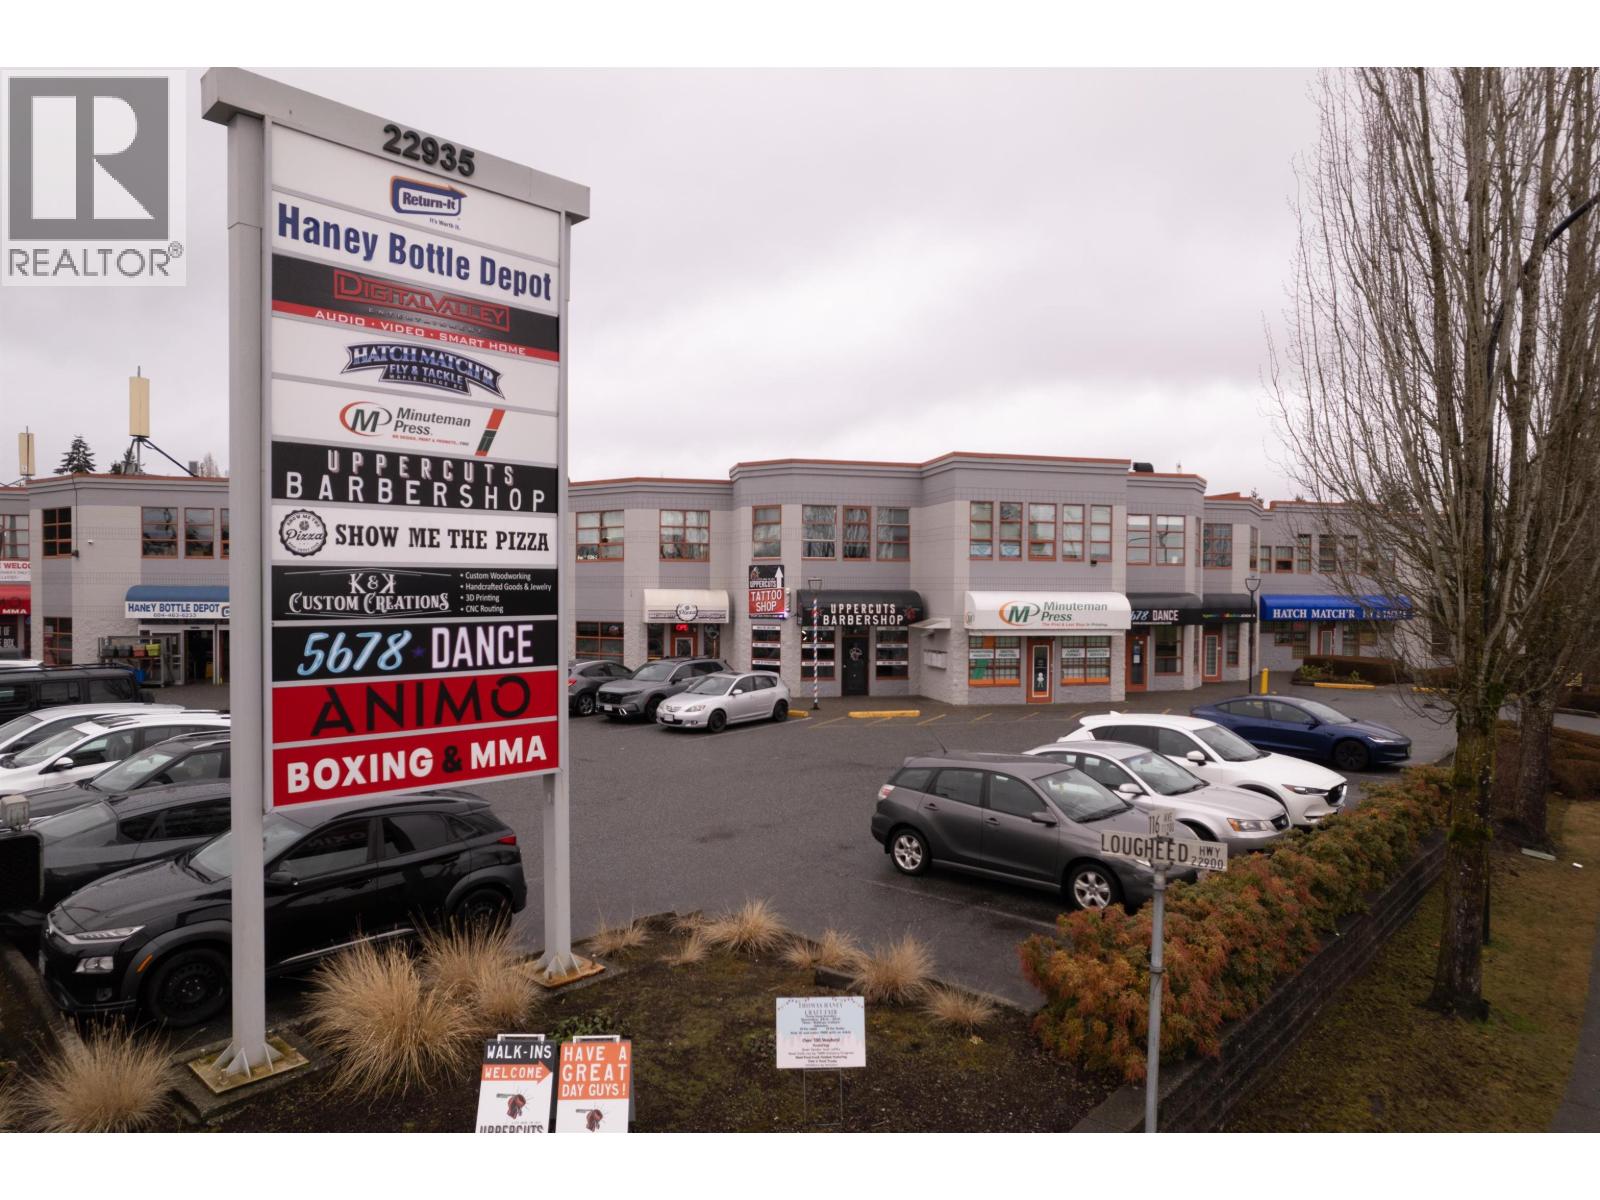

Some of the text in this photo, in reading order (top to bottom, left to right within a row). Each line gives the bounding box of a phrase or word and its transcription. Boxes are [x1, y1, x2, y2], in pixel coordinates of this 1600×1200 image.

[383, 124, 476, 177] 22935
[402, 191, 456, 210] Return-It
[278, 203, 551, 301] Haney Bottle Depot
[315, 310, 527, 356] AUDIO VIDEO SMART HOME
[353, 345, 496, 388] HATCH MATCH'R
[389, 363, 464, 384] FLY & TACKLE
[395, 407, 471, 428] Minuteman
[327, 449, 515, 486] UPPERCUTS
[286, 471, 545, 512] BARBERSHOP
[285, 528, 324, 542] Pizza
[335, 523, 399, 548] SHOW
[408, 527, 441, 549] ME
[448, 529, 488, 550] THE
[495, 531, 550, 552] PIZZA
[349, 573, 366, 594] K
[367, 575, 379, 590] &
[465, 572, 531, 582] Custom Woodworking
[465, 583, 503, 591] Handcrafted
[503, 583, 523, 591] Goods
[530, 583, 552, 592] Jewelry
[750, 590, 782, 602] TATTOO
[288, 592, 450, 614] CUSTOM CREATIONS
[465, 594, 500, 604] 3D Printing
[756, 601, 777, 613] SHOP
[1044, 601, 1108, 612] Minuteman
[128, 603, 220, 613] HANEY BOTTLE DEPOT
[465, 605, 504, 615] CNC Routing
[830, 603, 896, 614] UPPERCUTS
[1041, 611, 1073, 622] Press
[1152, 610, 1180, 621] DANCE
[1273, 608, 1307, 619] HATCH
[1311, 608, 1356, 619] MATCH'R
[823, 614, 904, 626] BARBERSHOP
[297, 624, 534, 676] 5678 DANCE
[310, 675, 531, 737] ANIMO
[287, 735, 547, 794] BOXING & MMA
[1148, 815, 1160, 835] 116
[1101, 833, 1221, 863] LOUGHEED HWY
[1191, 855, 1224, 870] 22900
[487, 1044, 551, 1059] WALK-INS
[563, 1045, 628, 1062] HAVE A
[484, 1066, 544, 1079] WELCOME
[562, 1063, 628, 1082] GREAT
[561, 1083, 586, 1097] DAY
